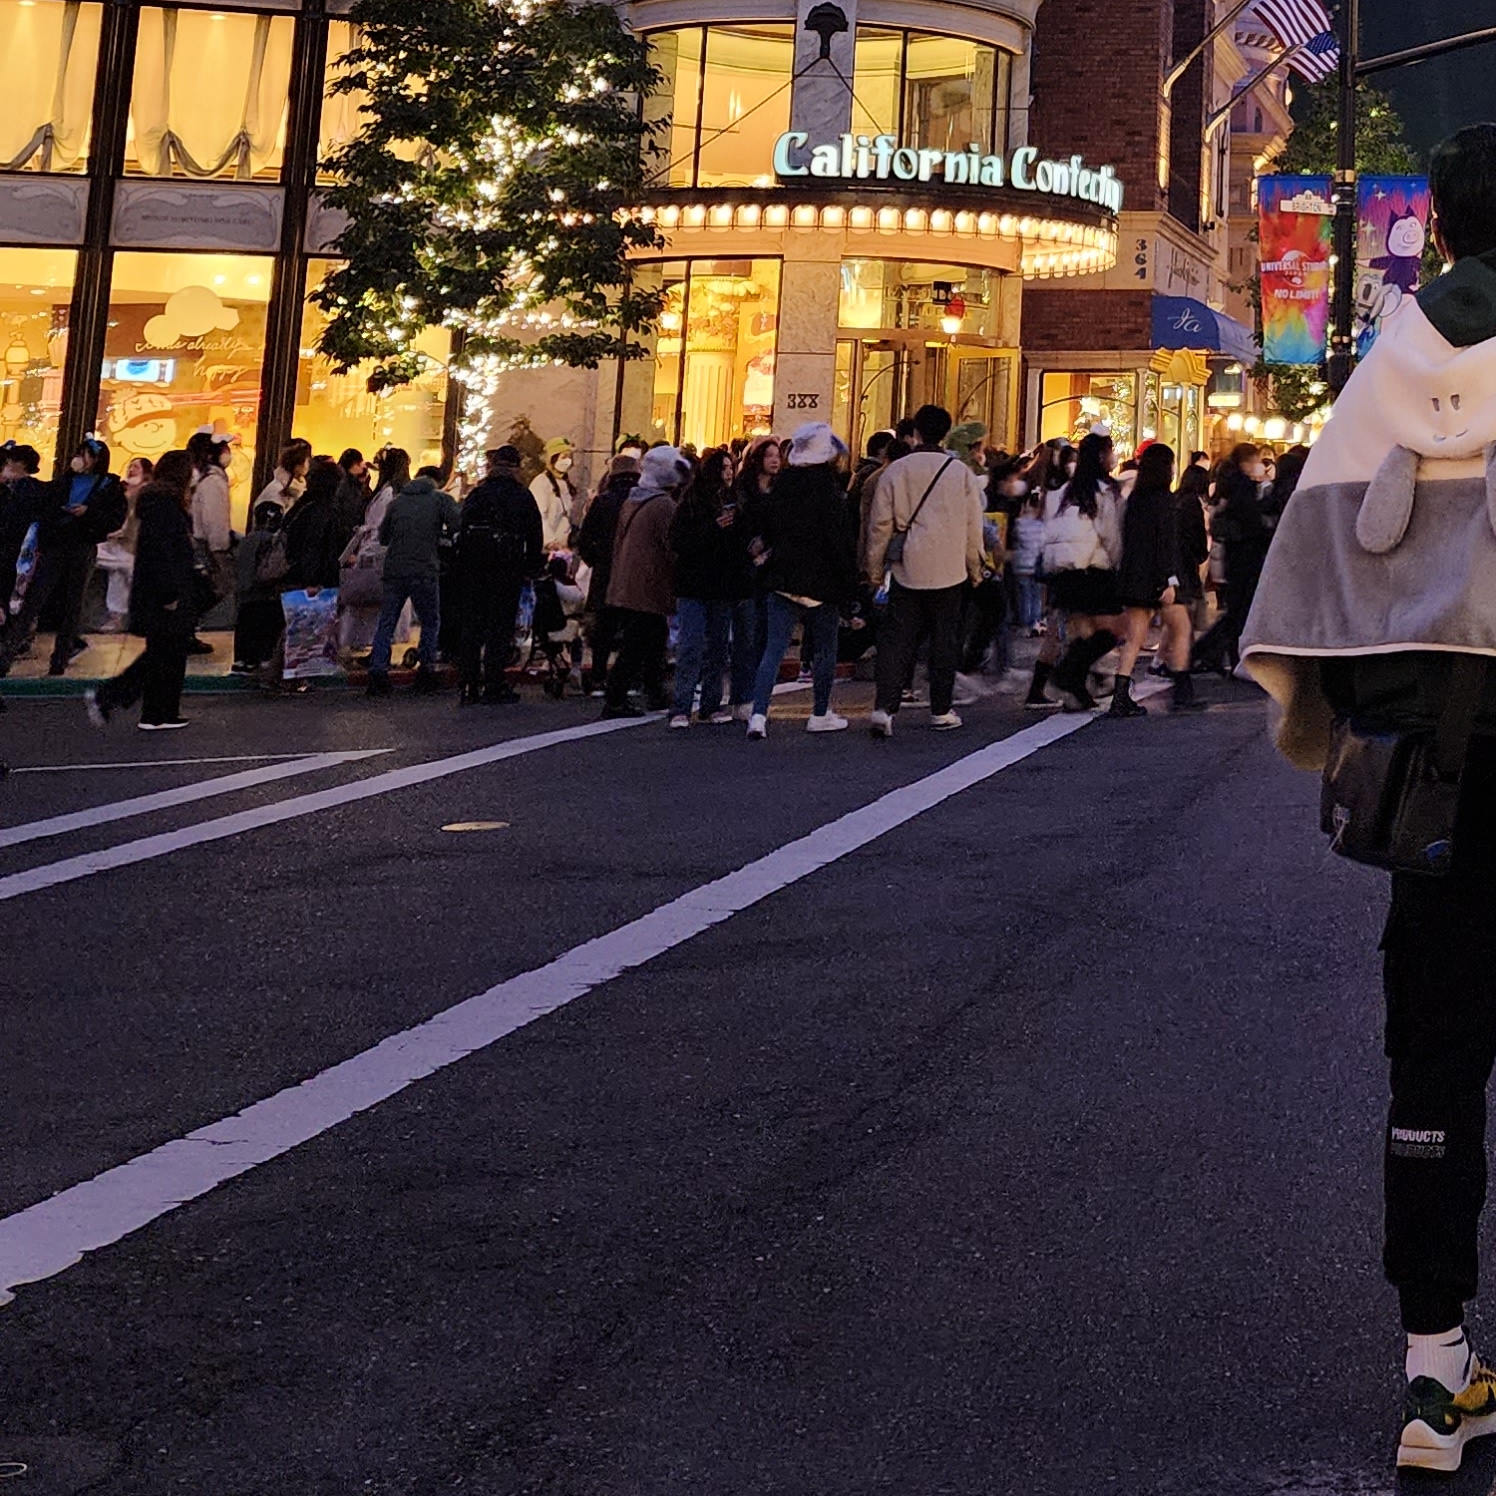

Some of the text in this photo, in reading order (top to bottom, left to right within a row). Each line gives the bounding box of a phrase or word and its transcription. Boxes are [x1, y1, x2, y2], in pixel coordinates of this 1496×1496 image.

[772, 131, 1004, 187] California
[1274, 288, 1289, 299] NO
[787, 393, 820, 409] 388
